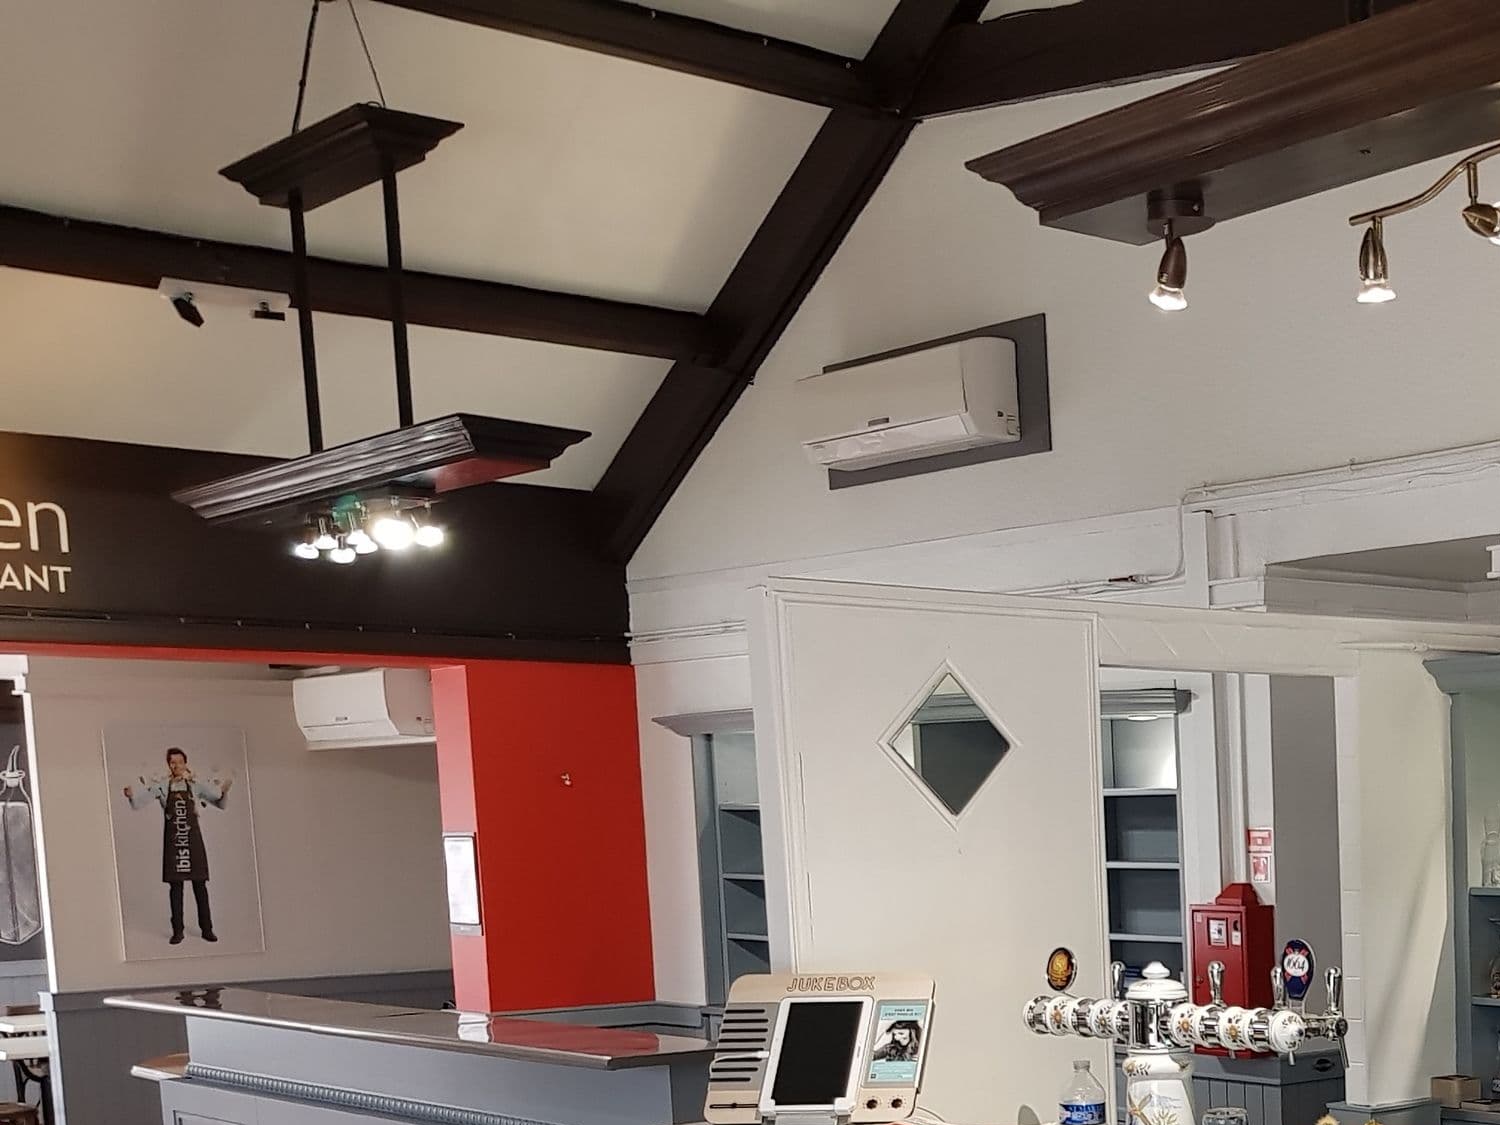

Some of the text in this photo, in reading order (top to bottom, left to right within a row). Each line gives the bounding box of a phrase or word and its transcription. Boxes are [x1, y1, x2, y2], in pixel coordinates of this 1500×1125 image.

[173, 799, 192, 873] ibis kitchen
[1286, 957, 1305, 971] 1664
[786, 976, 876, 992] JUKEBOX
